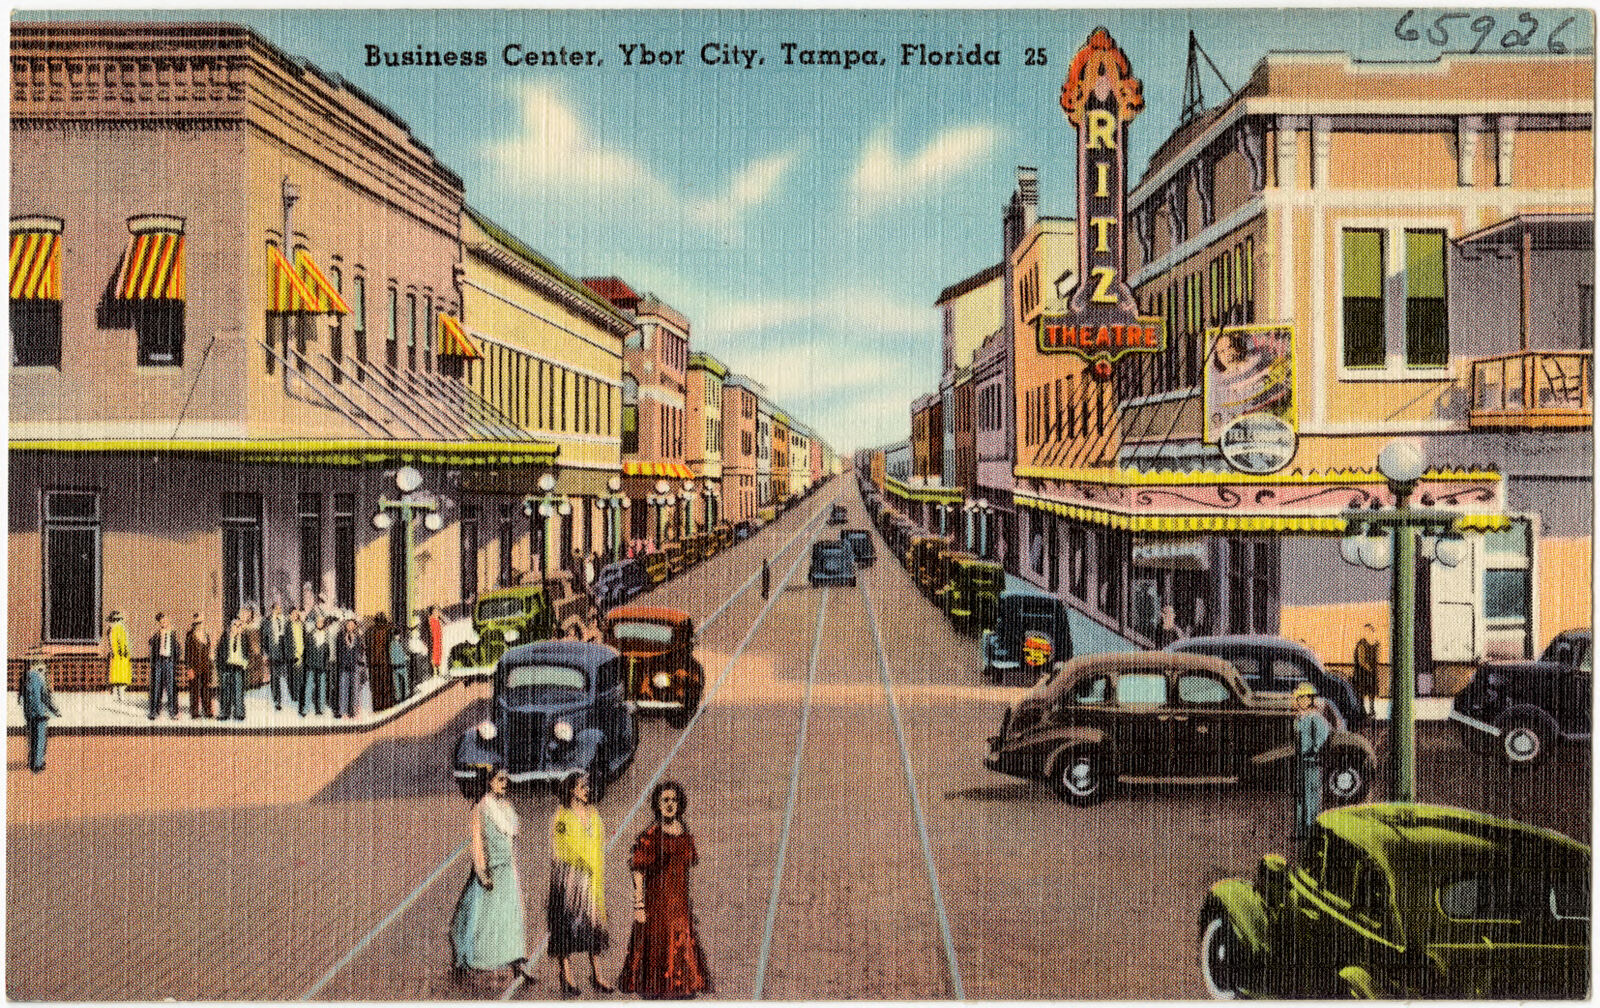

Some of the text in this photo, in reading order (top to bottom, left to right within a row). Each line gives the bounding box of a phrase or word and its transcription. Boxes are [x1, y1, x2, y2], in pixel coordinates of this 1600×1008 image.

[1394, 9, 1575, 55] 65926
[1086, 109, 1118, 304] RITZ
[1046, 324, 1159, 348] THEATRE
